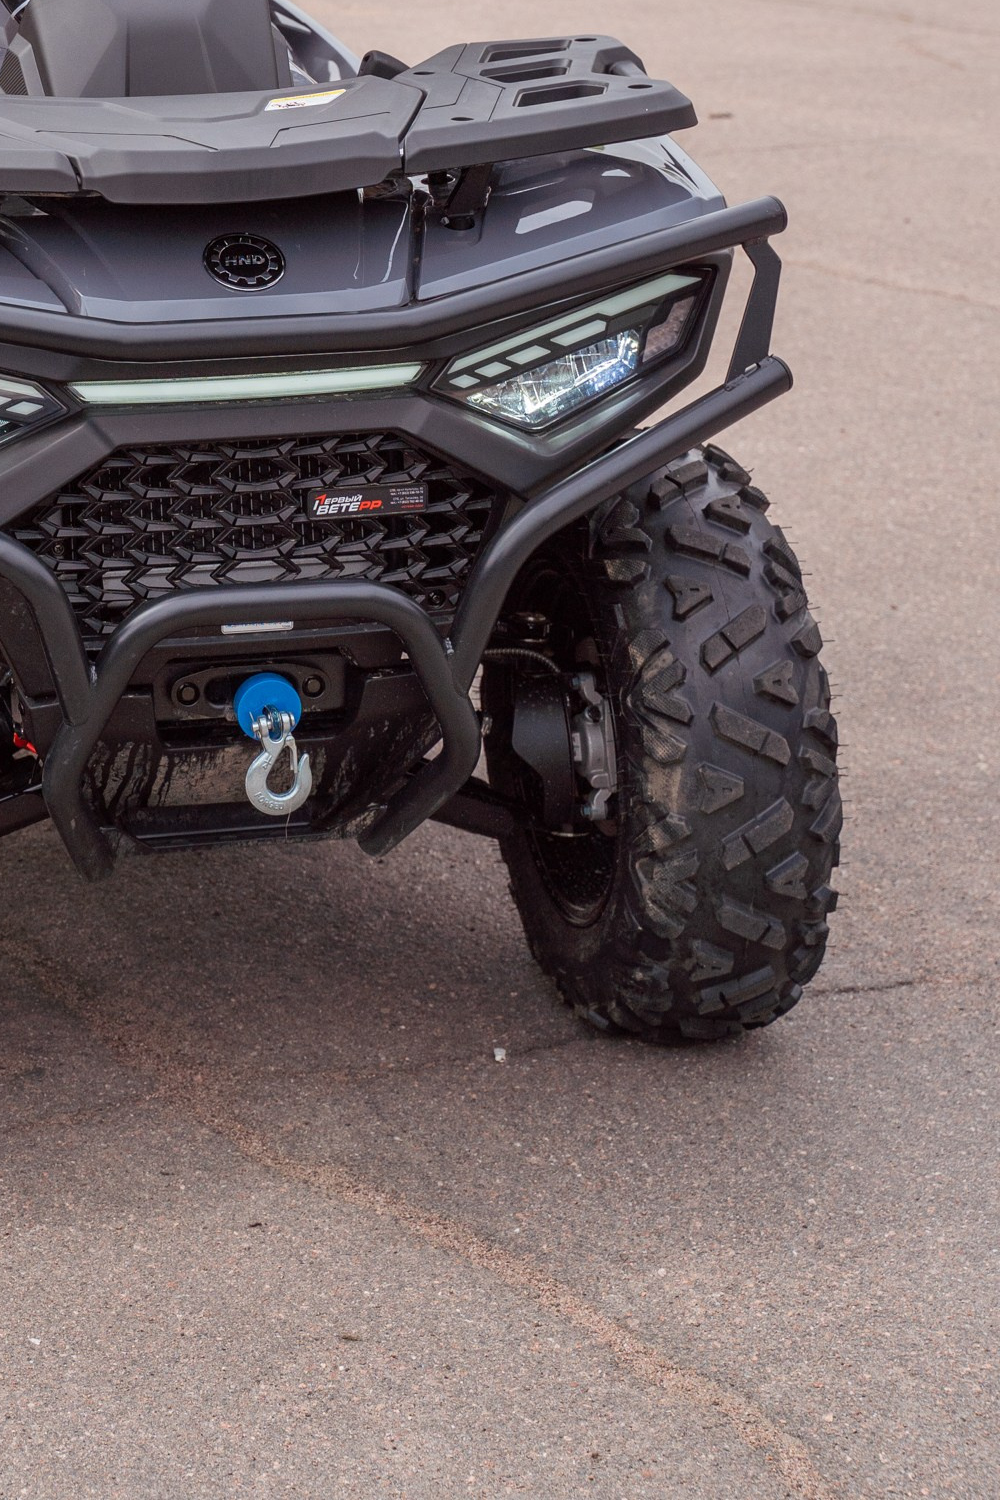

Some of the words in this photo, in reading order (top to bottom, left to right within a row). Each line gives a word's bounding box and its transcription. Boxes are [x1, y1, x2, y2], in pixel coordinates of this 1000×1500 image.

[225, 254, 266, 266] HND
[316, 500, 383, 516] ВЕТЕРР
[254, 791, 285, 810] FORGED
